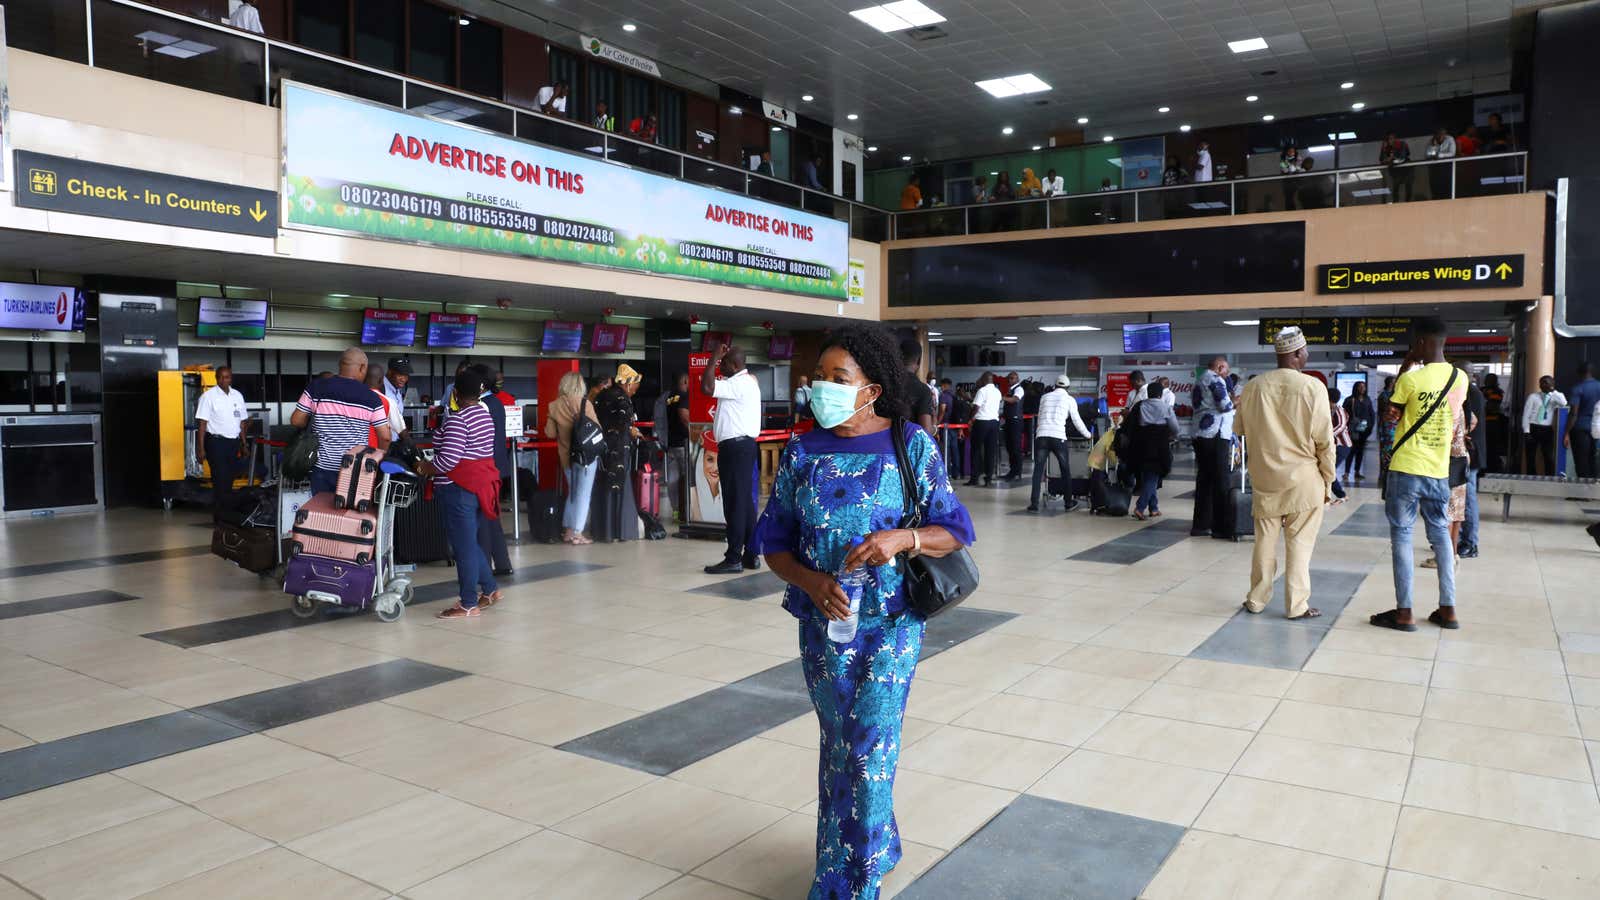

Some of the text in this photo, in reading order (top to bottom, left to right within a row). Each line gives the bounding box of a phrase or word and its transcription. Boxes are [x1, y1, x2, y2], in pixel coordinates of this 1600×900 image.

[389, 133, 585, 195] ADVERTISE ON THIS
[66, 178, 128, 201] Check
[144, 190, 161, 206] In
[166, 193, 241, 216] Counters
[466, 191, 499, 206] PLEASE
[341, 185, 615, 244] 08023046179 08185553549 08024724484
[705, 203, 814, 242] ADVERTISE ON THIS
[679, 242, 734, 263] 08023046179
[737, 253, 786, 272] 08185553549
[1354, 264, 1491, 284] Departures Wing D
[4, 298, 56, 315] TURKISH AIRLINES
